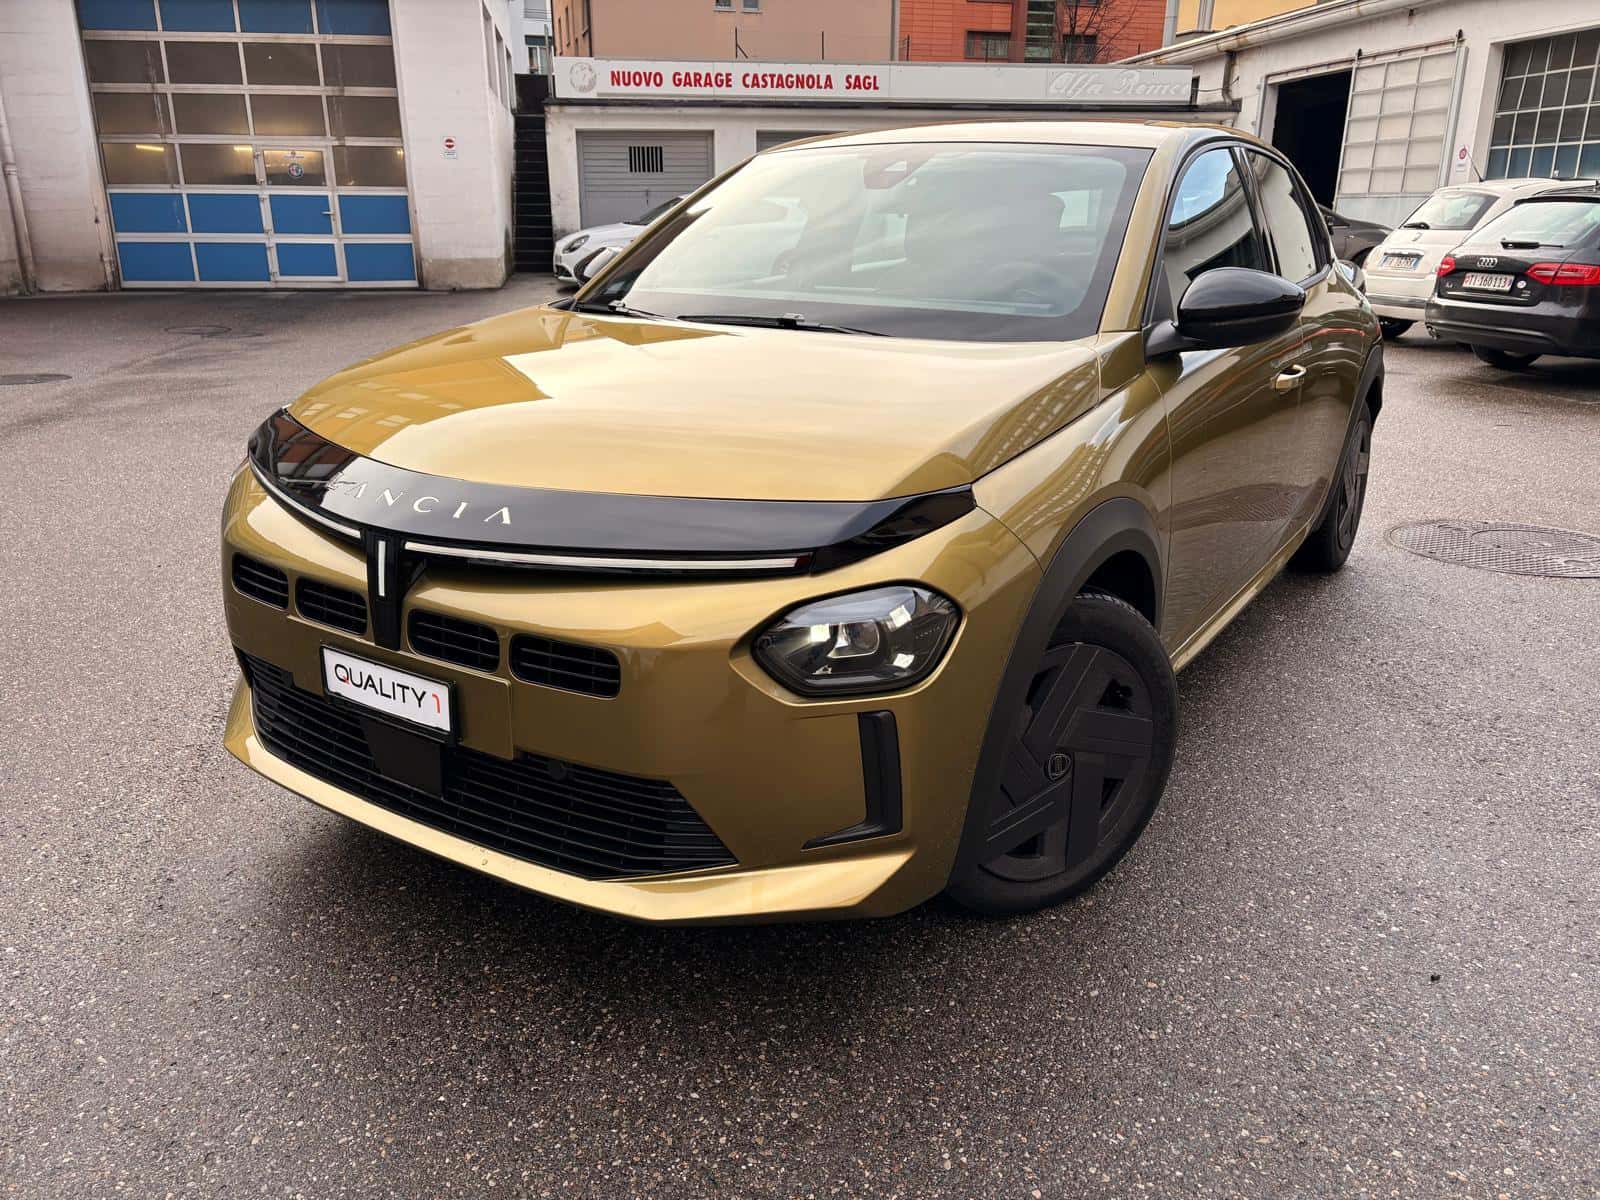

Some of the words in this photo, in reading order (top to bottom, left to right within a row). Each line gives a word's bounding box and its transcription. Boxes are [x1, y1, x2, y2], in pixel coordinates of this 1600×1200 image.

[610, 70, 664, 88] NUOVO
[672, 71, 733, 88] GARAGE
[742, 73, 834, 90] CASTAGNOLA
[845, 74, 880, 91] SAGL
[334, 663, 427, 708] QUALITY
